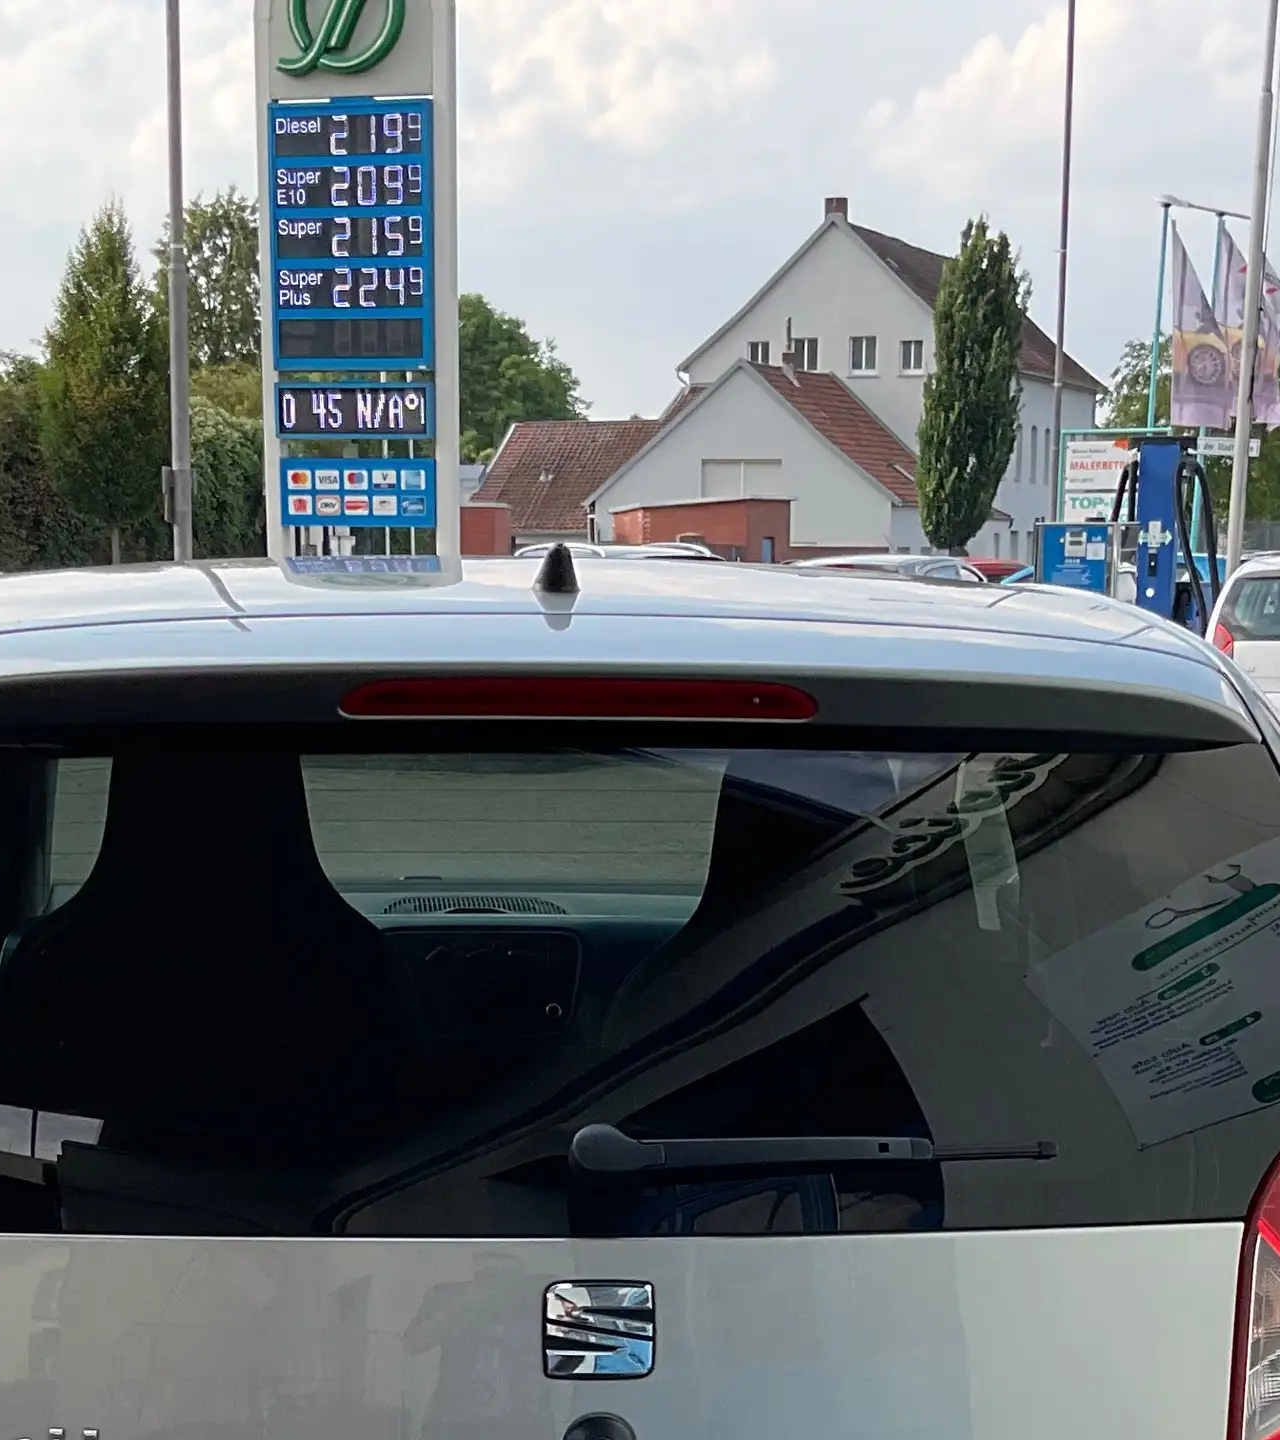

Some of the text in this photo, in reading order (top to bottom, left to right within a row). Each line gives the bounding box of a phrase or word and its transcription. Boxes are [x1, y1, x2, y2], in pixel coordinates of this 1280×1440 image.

[275, 116, 320, 134] Diesel
[277, 168, 320, 187] Super
[277, 189, 306, 205] E10
[278, 219, 322, 238] Super
[279, 270, 323, 289] Super
[279, 290, 312, 306] Plus
[318, 475, 338, 484] VISA
